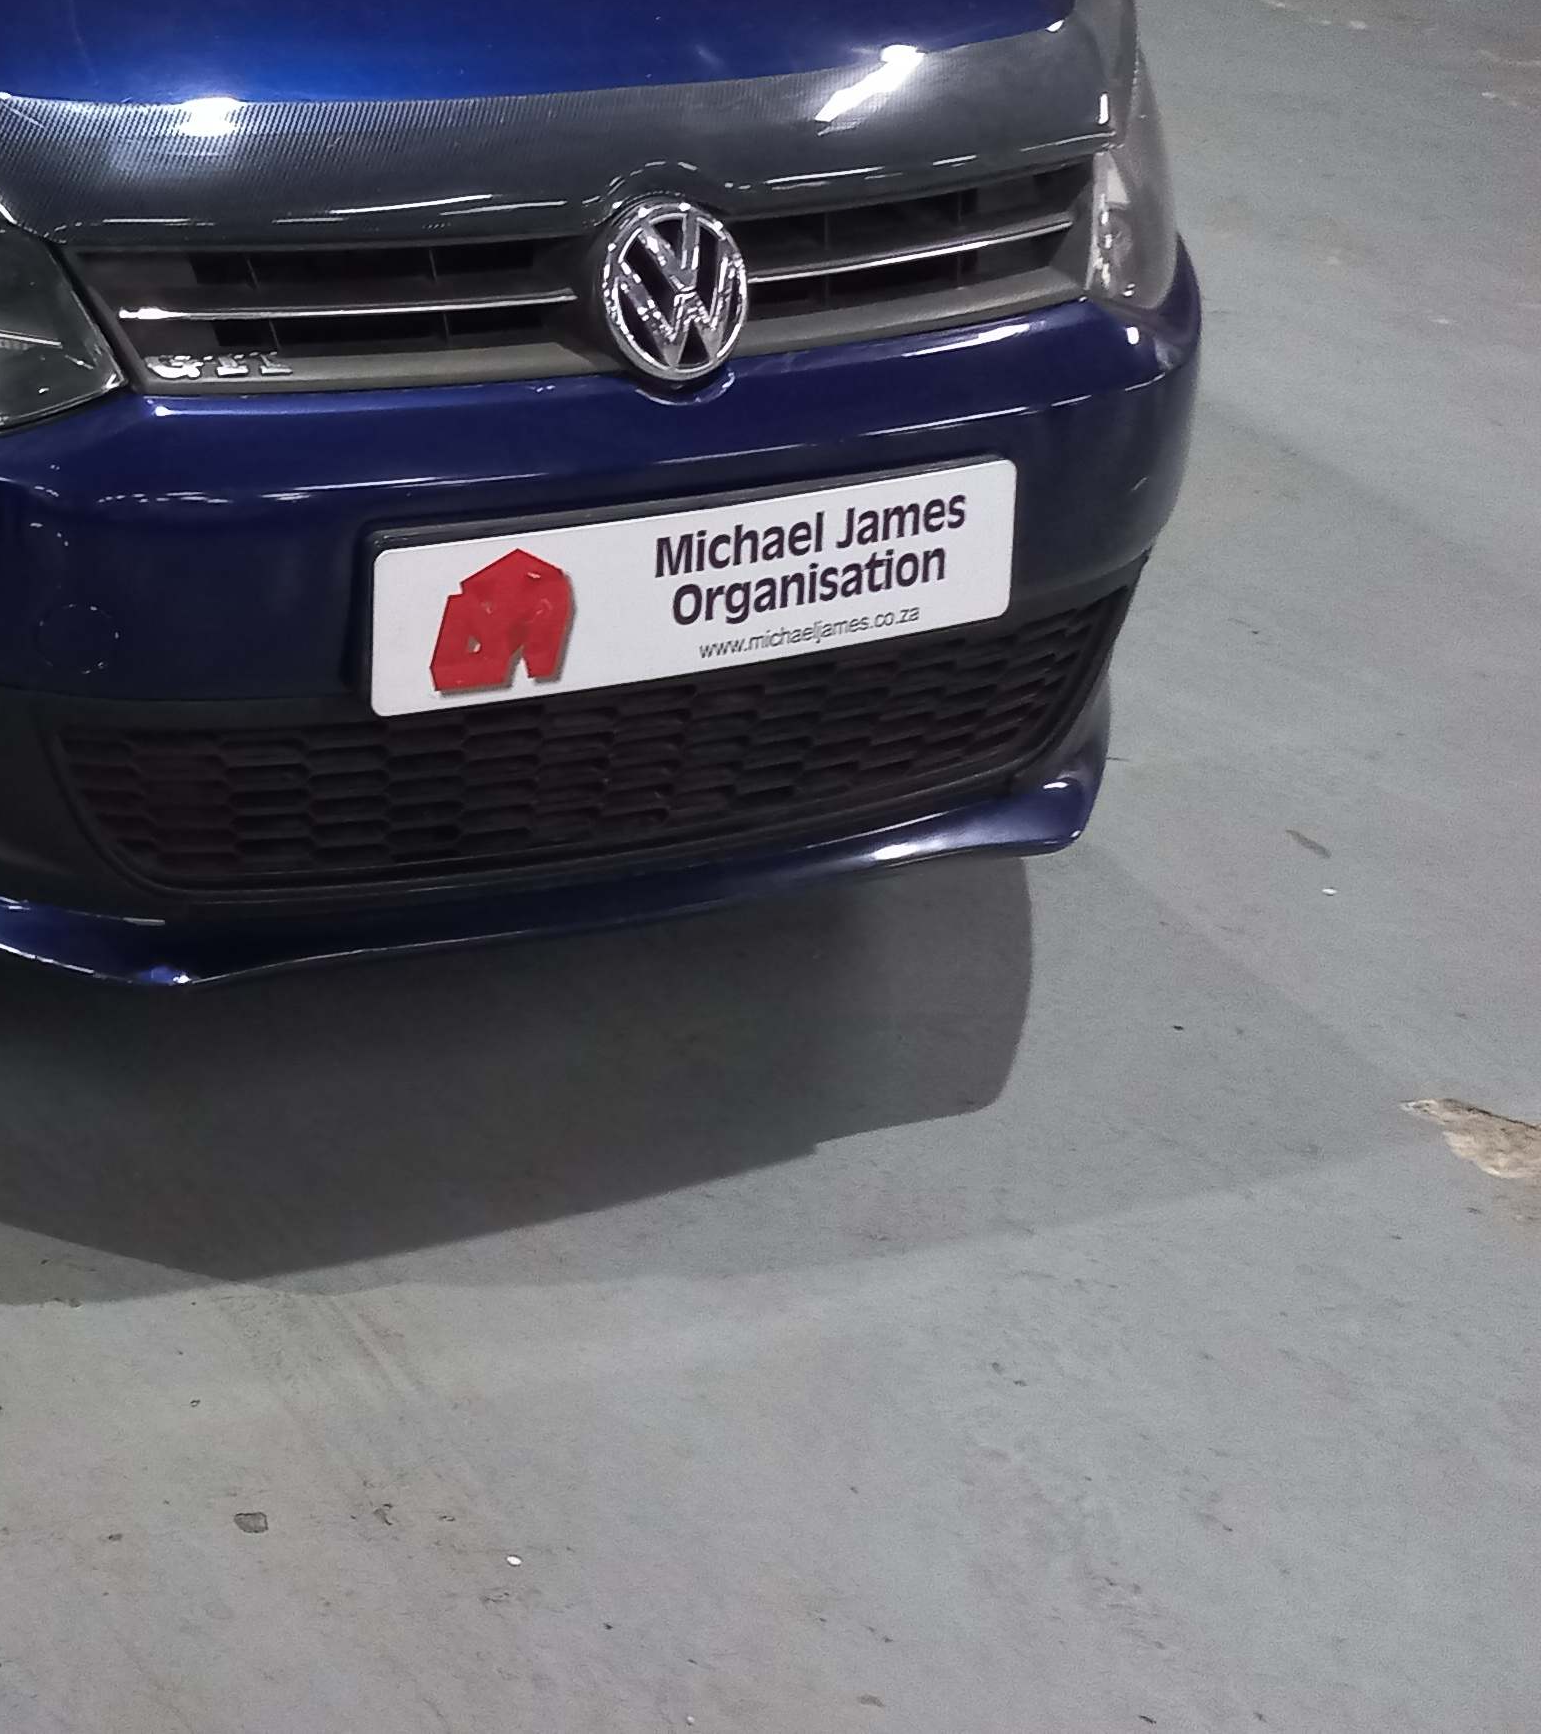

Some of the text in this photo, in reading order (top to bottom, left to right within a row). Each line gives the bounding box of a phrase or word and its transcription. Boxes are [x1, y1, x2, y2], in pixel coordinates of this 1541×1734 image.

[654, 492, 967, 578] Michael James
[672, 546, 947, 628] Organisation
[698, 603, 921, 660] www.michaeljames.co.za
